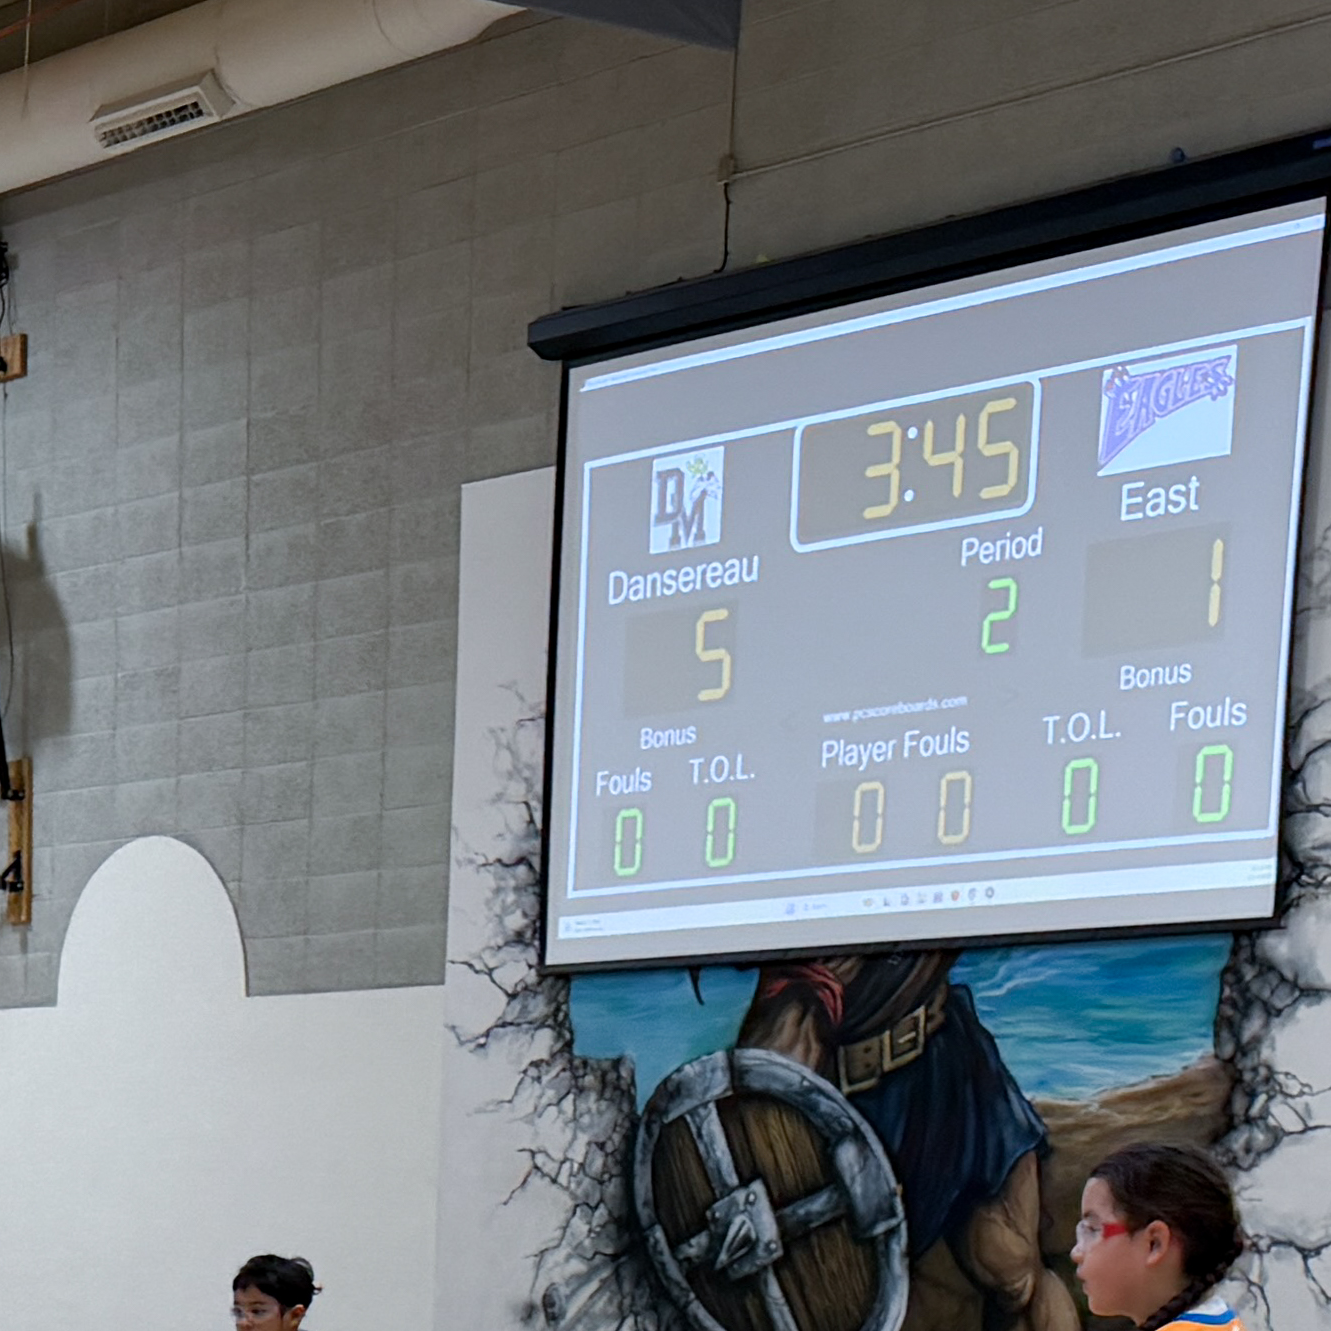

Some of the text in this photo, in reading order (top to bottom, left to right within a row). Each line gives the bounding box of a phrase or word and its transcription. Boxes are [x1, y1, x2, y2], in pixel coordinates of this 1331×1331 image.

[863, 397, 1019, 519] 3:45
[1120, 475, 1200, 521] East
[961, 526, 1043, 567] Period
[608, 555, 760, 605] Dansereau
[1208, 538, 1224, 627] 1
[981, 577, 1018, 654] 2
[695, 608, 732, 701] 5
[1119, 663, 1193, 690] Bonus
[640, 726, 696, 749] Bonus
[1042, 710, 1121, 744] T.O.L.
[1170, 696, 1247, 731] Fouls
[689, 753, 755, 785] T.O.L.
[822, 726, 970, 771] Player Fouls
[596, 767, 652, 796] Fouls
[1062, 757, 1099, 835] 0
[1192, 744, 1234, 823] 0
[706, 797, 736, 867] 0
[852, 770, 972, 853] 0 0
[614, 808, 643, 876] 0
